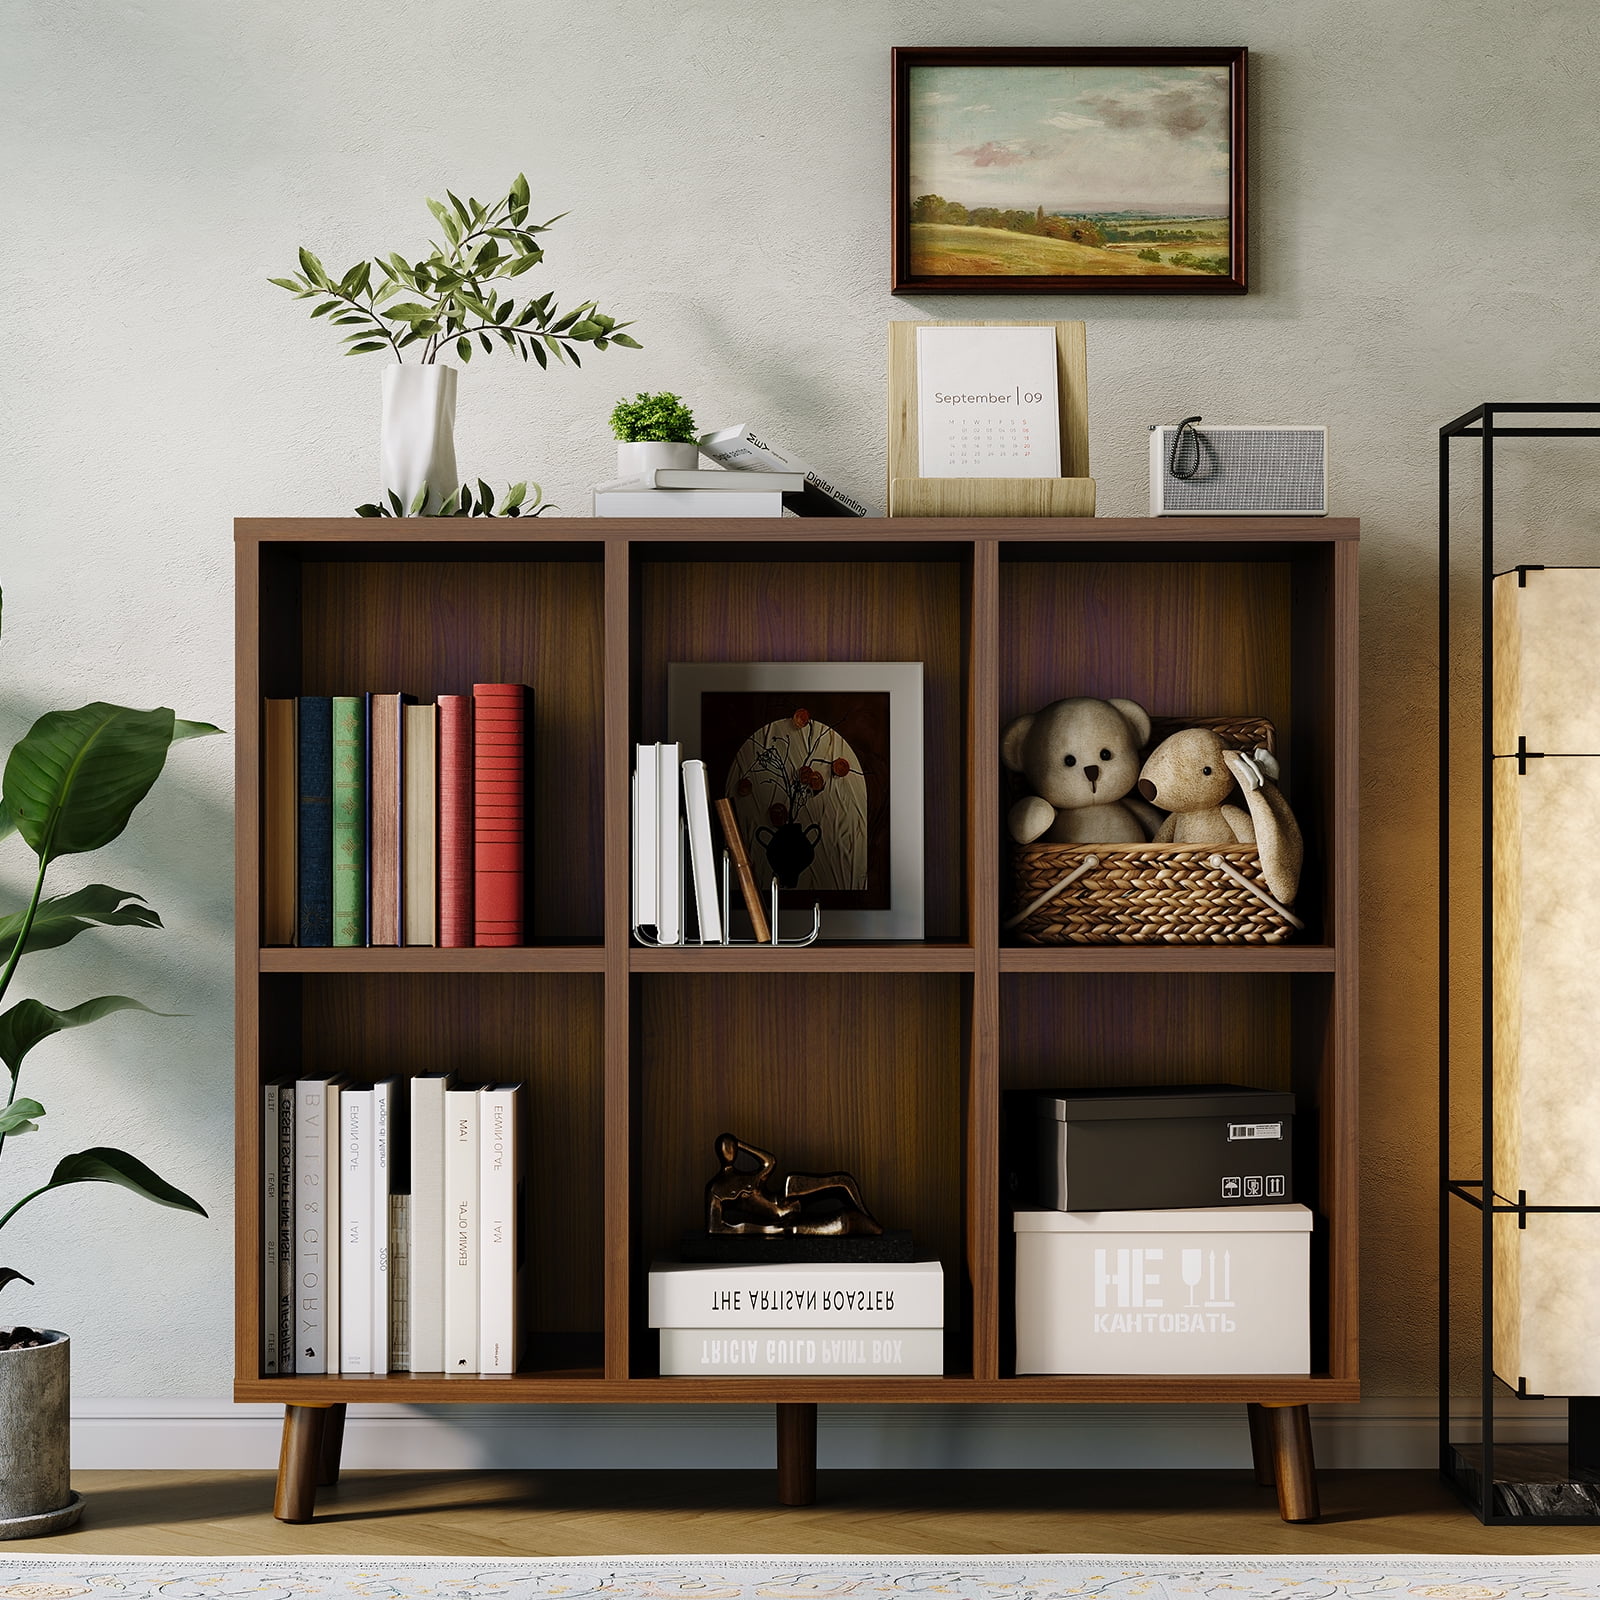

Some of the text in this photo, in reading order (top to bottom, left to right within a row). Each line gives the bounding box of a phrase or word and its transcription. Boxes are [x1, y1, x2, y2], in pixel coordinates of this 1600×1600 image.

[934, 392, 1043, 406] September 09
[806, 471, 868, 517] Digital painting
[1094, 1248, 1164, 1307] НЕ
[1094, 1313, 1237, 1333] КАНТОВАТЬ
